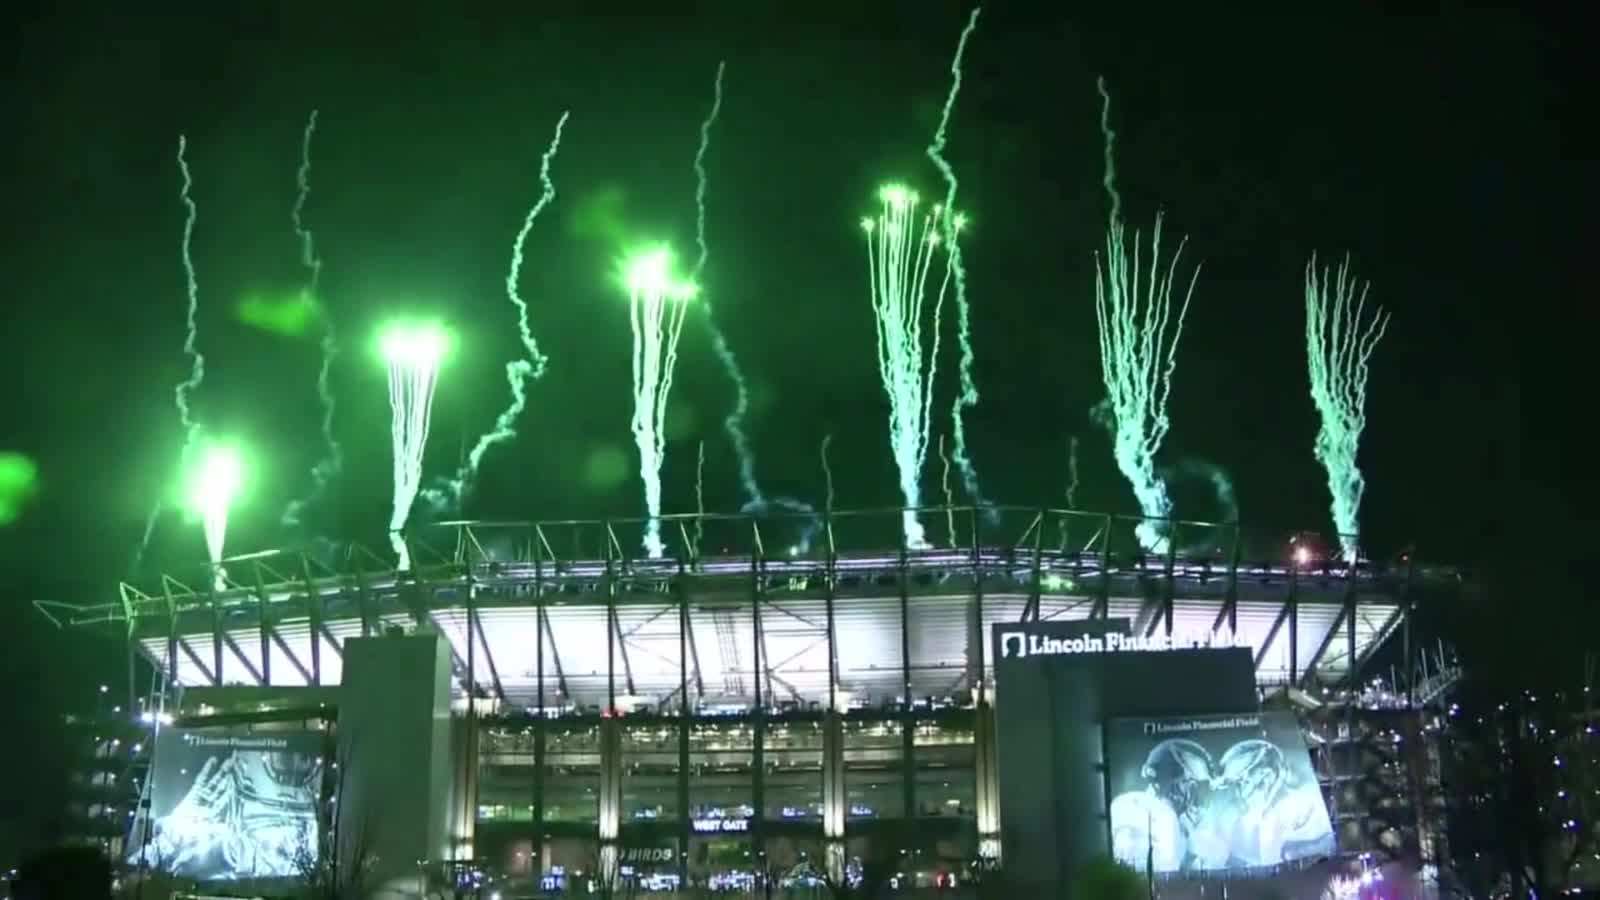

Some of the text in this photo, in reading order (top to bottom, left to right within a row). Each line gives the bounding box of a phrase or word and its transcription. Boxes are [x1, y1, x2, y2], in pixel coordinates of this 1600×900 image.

[1029, 632, 1103, 655] Lincoln
[693, 820, 747, 831] WEST GATE
